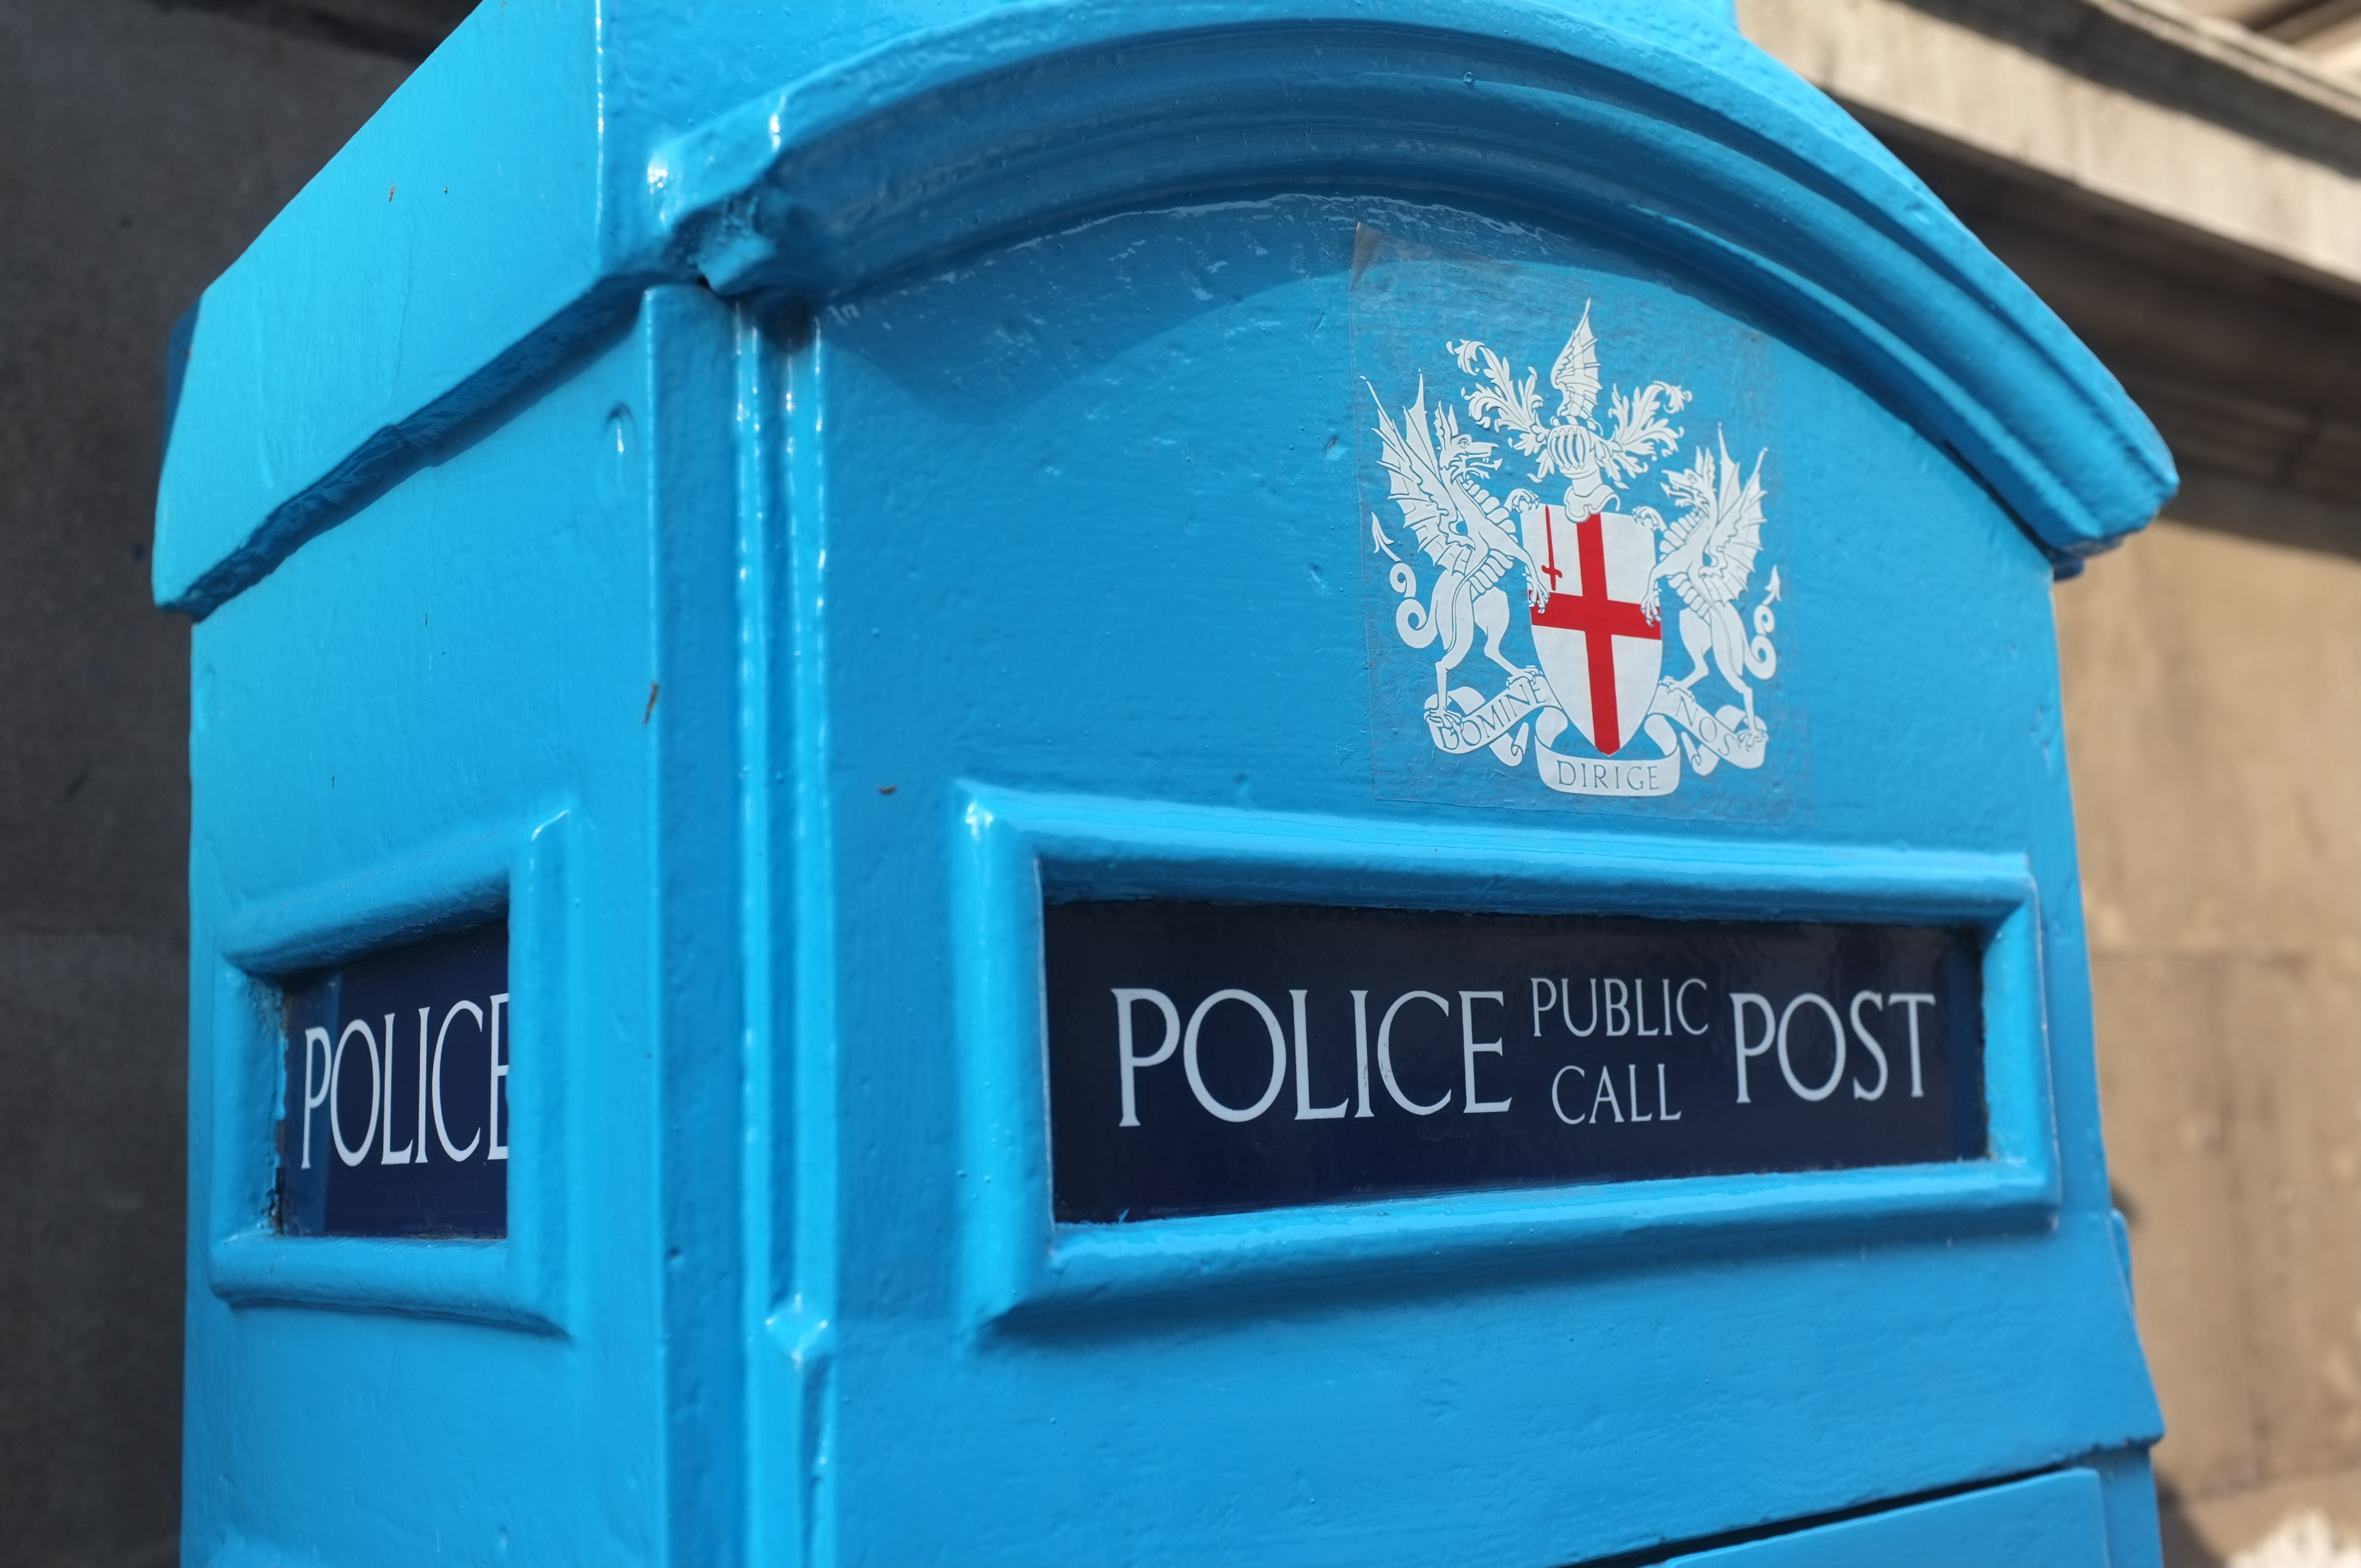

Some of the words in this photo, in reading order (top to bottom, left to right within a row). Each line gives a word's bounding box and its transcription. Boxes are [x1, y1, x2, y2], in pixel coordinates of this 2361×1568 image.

[1436, 680, 1546, 750] DOMINE
[1556, 760, 1660, 791] DIRIGE
[1675, 695, 1736, 756] NOS
[1111, 988, 1512, 1126] POLICE
[1531, 978, 1708, 1037] PUBLIC
[1729, 990, 1935, 1103] POST
[301, 993, 509, 1169] POLICE
[1552, 1063, 1682, 1125] CALL
